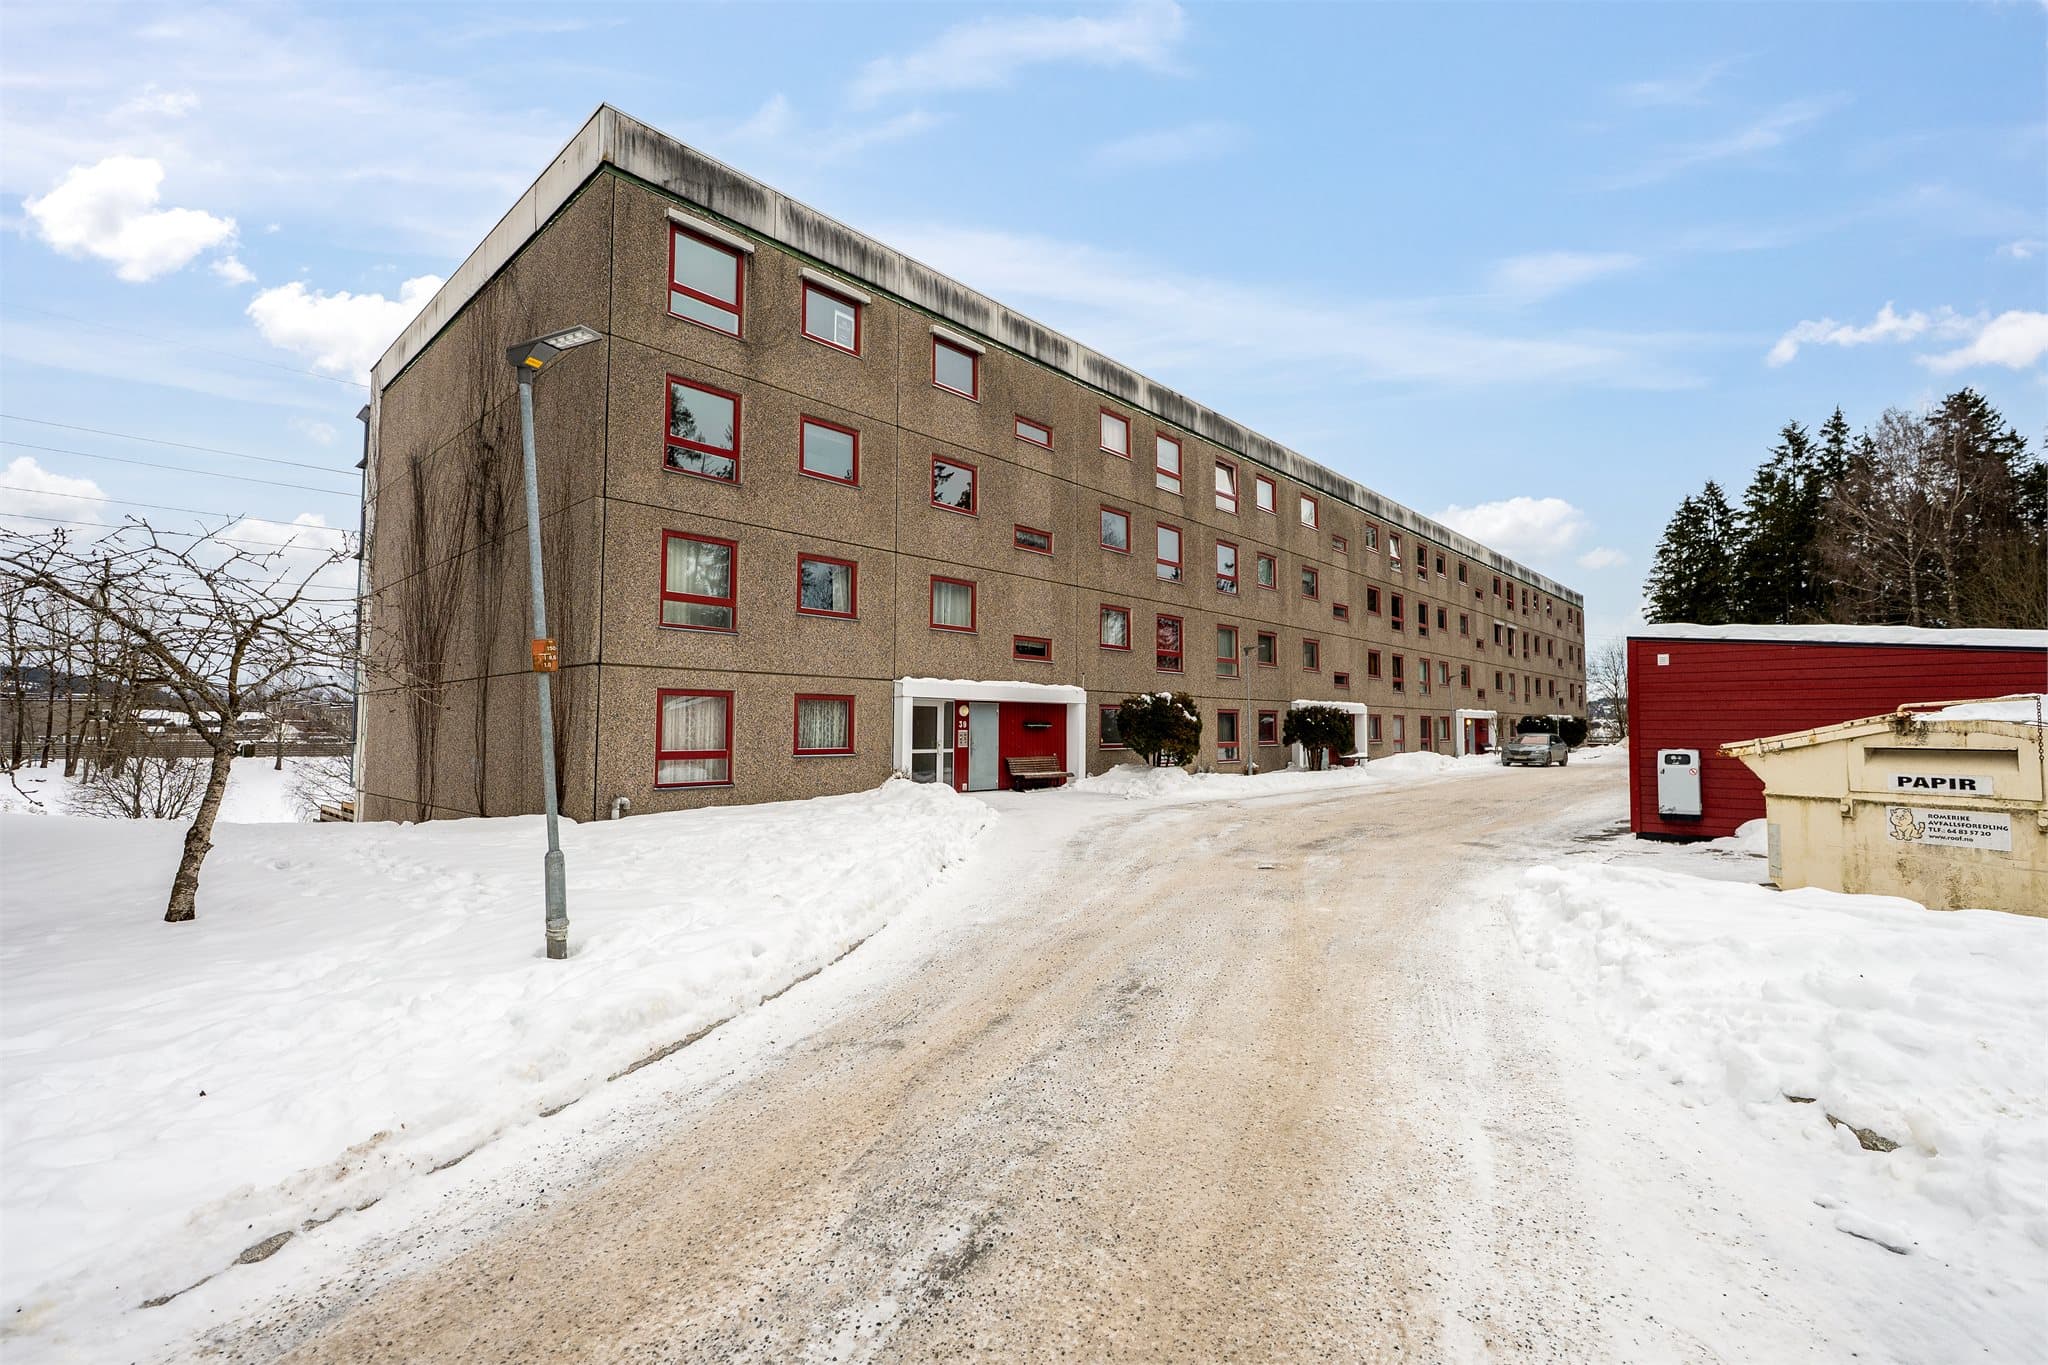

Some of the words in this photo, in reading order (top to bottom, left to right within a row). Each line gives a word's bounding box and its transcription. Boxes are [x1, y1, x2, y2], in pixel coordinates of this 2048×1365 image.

[1897, 776, 1977, 791] PAPIR
[1927, 813, 1970, 821] ROMERIKE
[1928, 821, 2009, 831] AVFALLSFOREDLING
